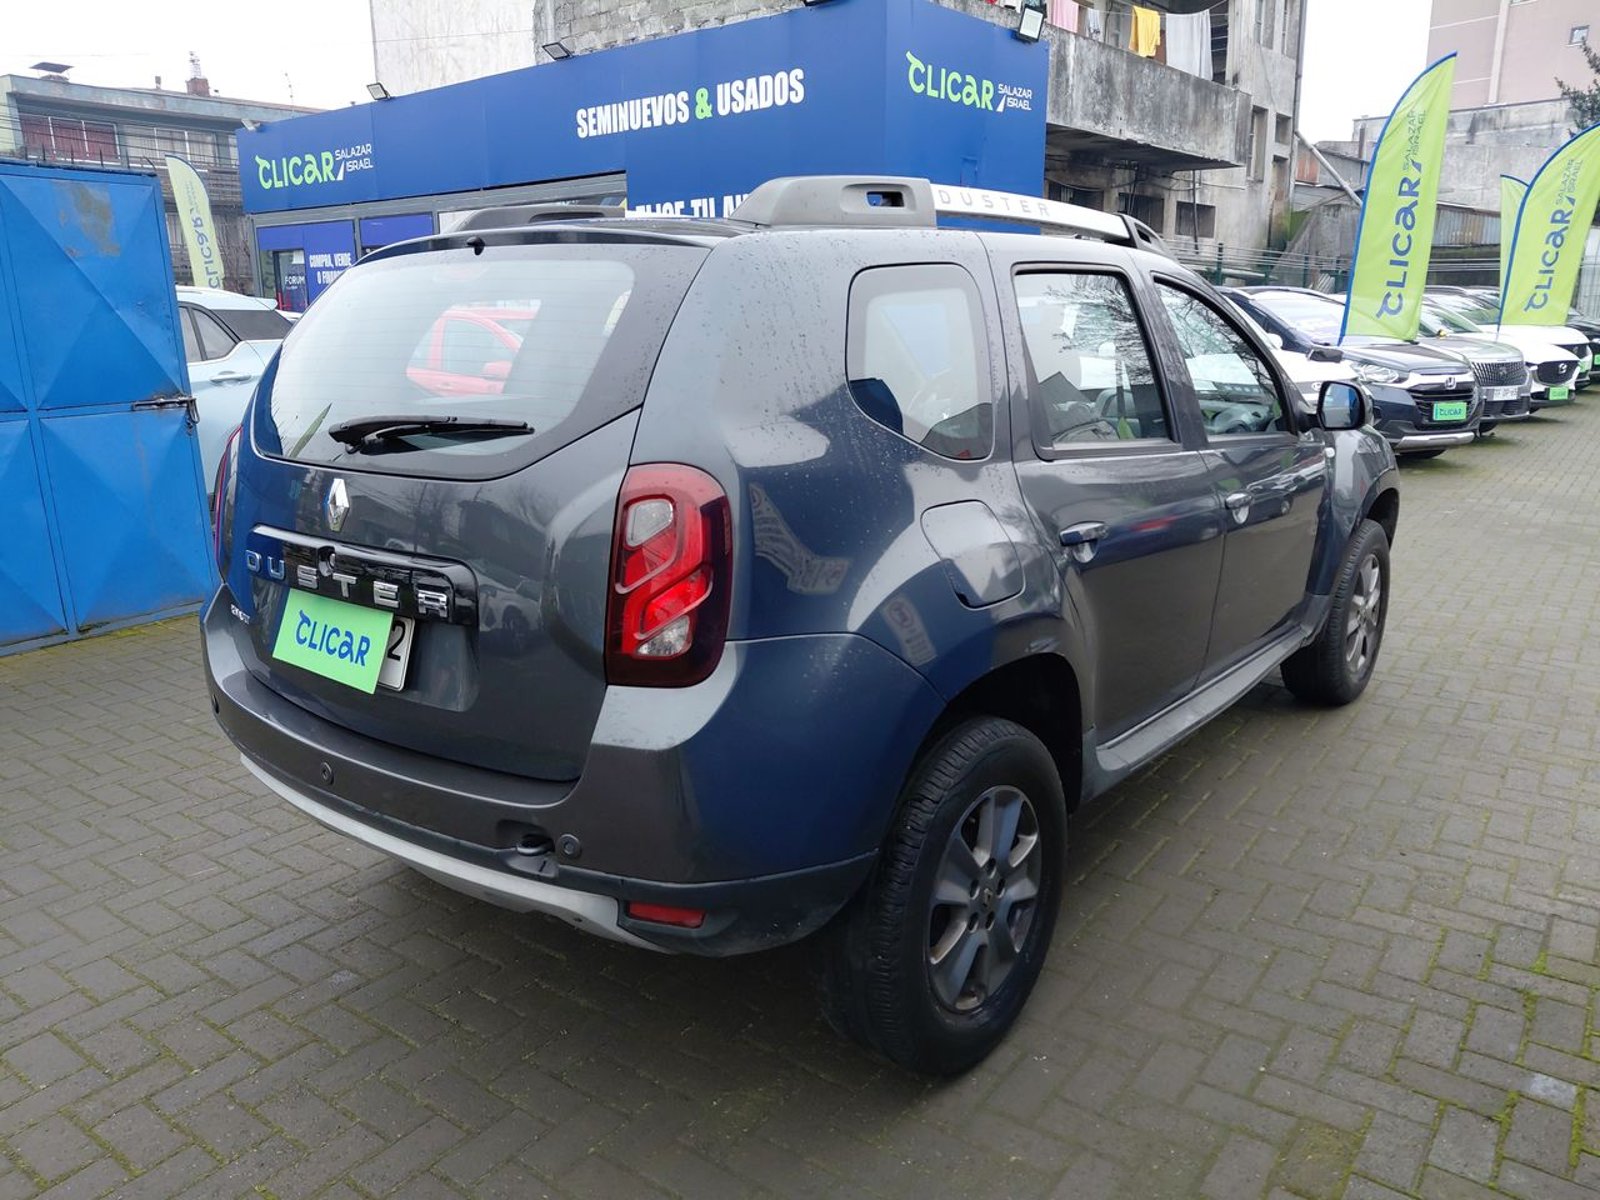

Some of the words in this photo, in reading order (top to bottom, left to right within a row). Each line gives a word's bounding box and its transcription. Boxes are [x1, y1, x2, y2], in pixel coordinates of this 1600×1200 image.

[998, 83, 1033, 100] SALAZAR
[576, 91, 690, 138] SEMINUEVOS
[695, 87, 712, 119] &
[717, 68, 805, 116] USADOS
[1006, 96, 1032, 111] ISRAEL
[335, 143, 373, 161] SALAZAR
[346, 158, 374, 172] ISRAEL
[938, 189, 1050, 217] DUSTER
[245, 549, 449, 618] DUSTER
